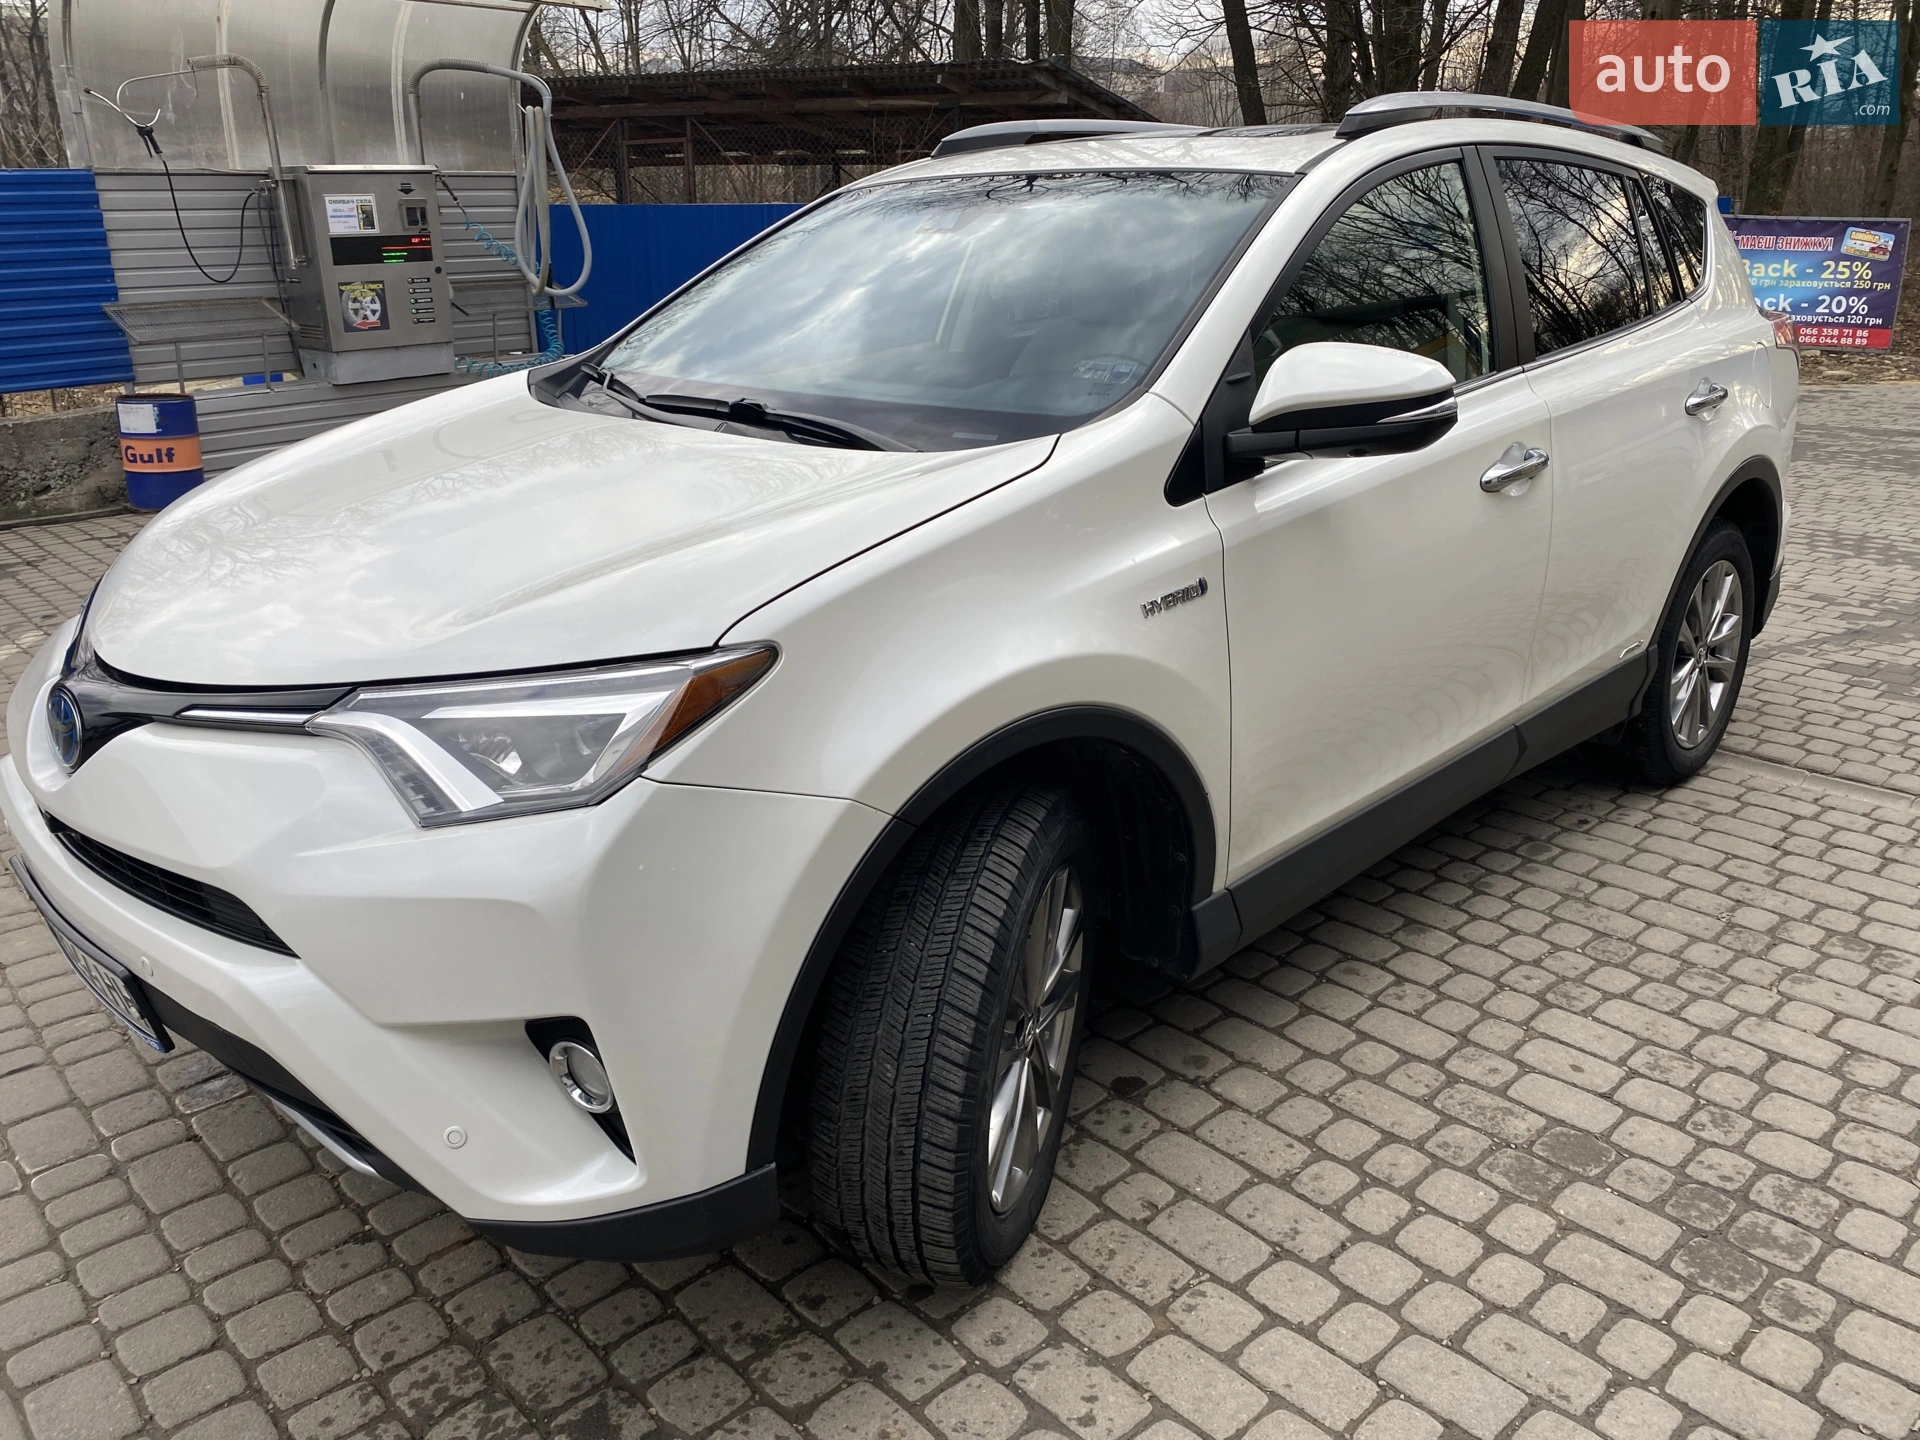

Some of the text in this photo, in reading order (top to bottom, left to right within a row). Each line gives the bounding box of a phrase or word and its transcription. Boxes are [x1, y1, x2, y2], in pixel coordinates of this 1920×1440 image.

[1777, 236, 1833, 251] ЗНИЖКУ!
[1820, 261, 1872, 279] 25%
[1778, 280, 1851, 289] зараховується
[1853, 280, 1871, 289] 250
[1873, 282, 1891, 291] грн
[1815, 295, 1868, 314] 20%
[1790, 315, 1883, 326] аховується 120 грн
[1800, 327, 1819, 335] 066
[1821, 328, 1839, 336] 358
[1843, 329, 1853, 337] 71
[1819, 336, 1838, 344] 044
[1840, 337, 1853, 345] 88
[124, 445, 175, 464] Gulf
[1140, 583, 1200, 619] HYBRID
